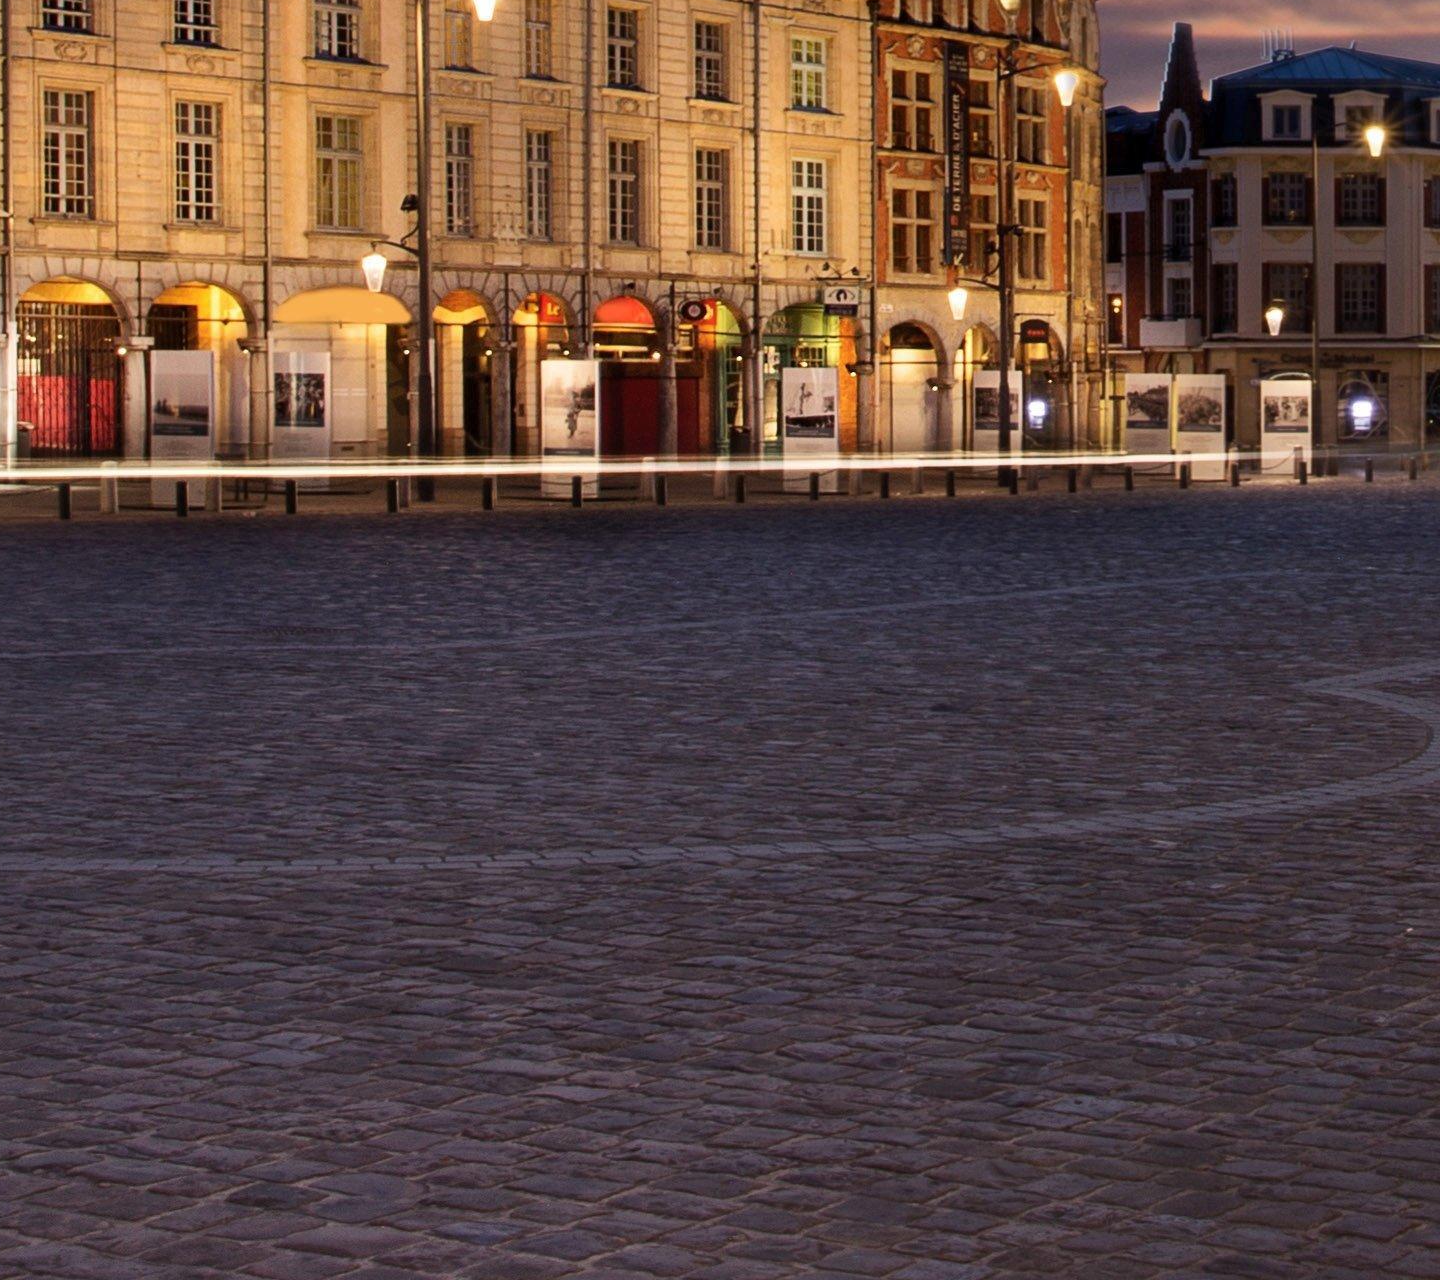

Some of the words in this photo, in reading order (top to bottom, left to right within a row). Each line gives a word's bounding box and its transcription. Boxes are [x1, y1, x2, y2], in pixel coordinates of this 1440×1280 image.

[952, 94, 960, 141] D'ACIER
[952, 155, 960, 193] TERRE
[952, 196, 961, 212] DE
